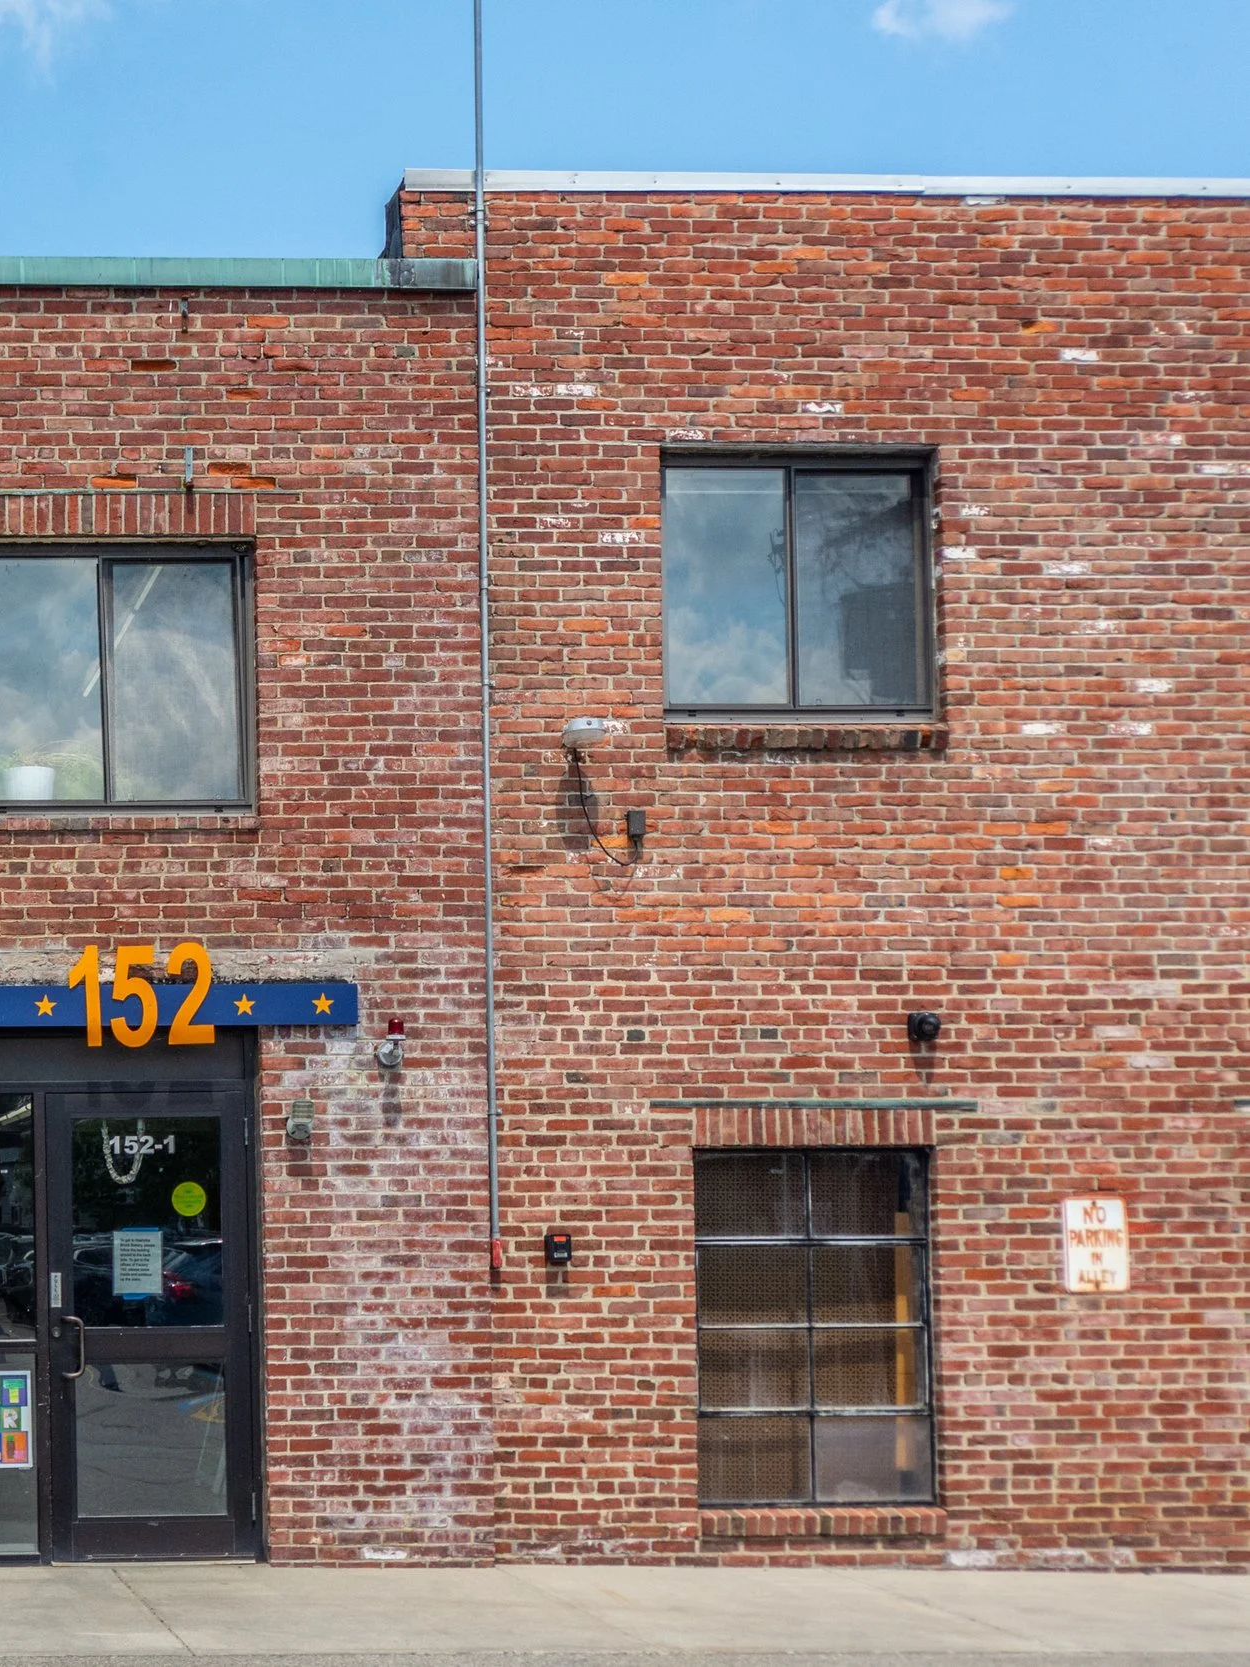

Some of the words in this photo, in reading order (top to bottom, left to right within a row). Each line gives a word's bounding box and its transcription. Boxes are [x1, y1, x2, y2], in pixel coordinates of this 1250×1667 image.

[68, 942, 215, 1048] 152
[108, 1135, 175, 1155] 152-1
[1082, 1206, 1106, 1224] NO
[1069, 1229, 1123, 1247] PARKING
[1077, 1269, 1117, 1284] ALLEY
